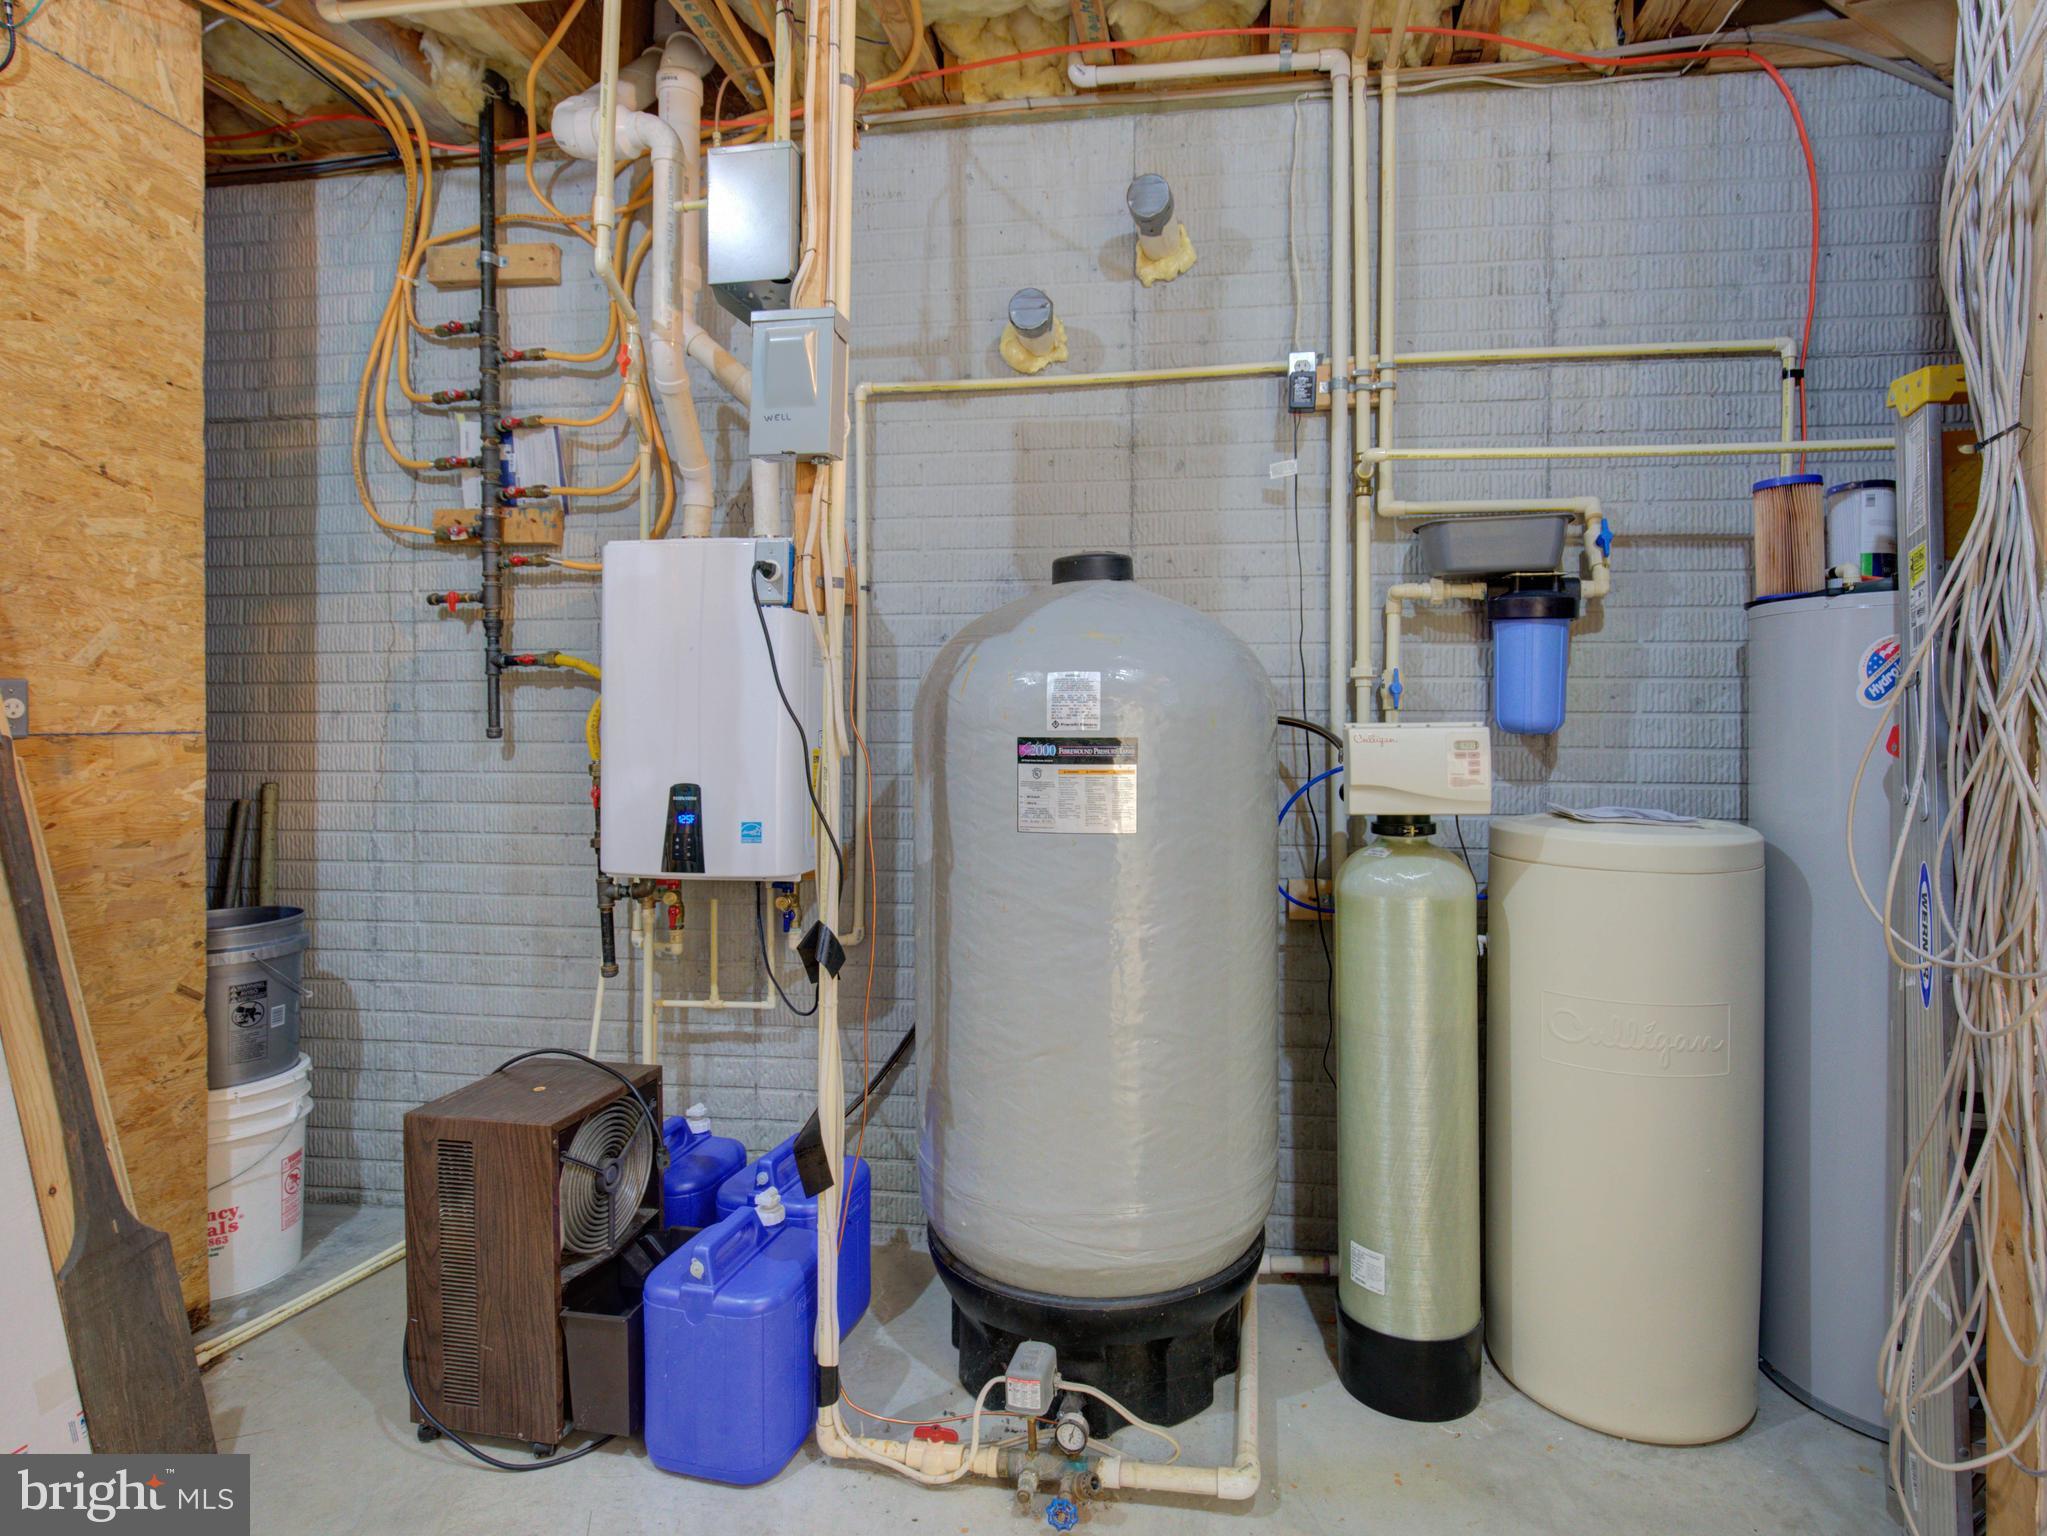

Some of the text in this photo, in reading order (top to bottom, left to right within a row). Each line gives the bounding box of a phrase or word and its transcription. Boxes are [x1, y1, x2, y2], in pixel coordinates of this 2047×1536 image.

[763, 413, 792, 422] WELL
[1921, 893, 1929, 980] WERNR
[1551, 1008, 1725, 1070] Culligan
